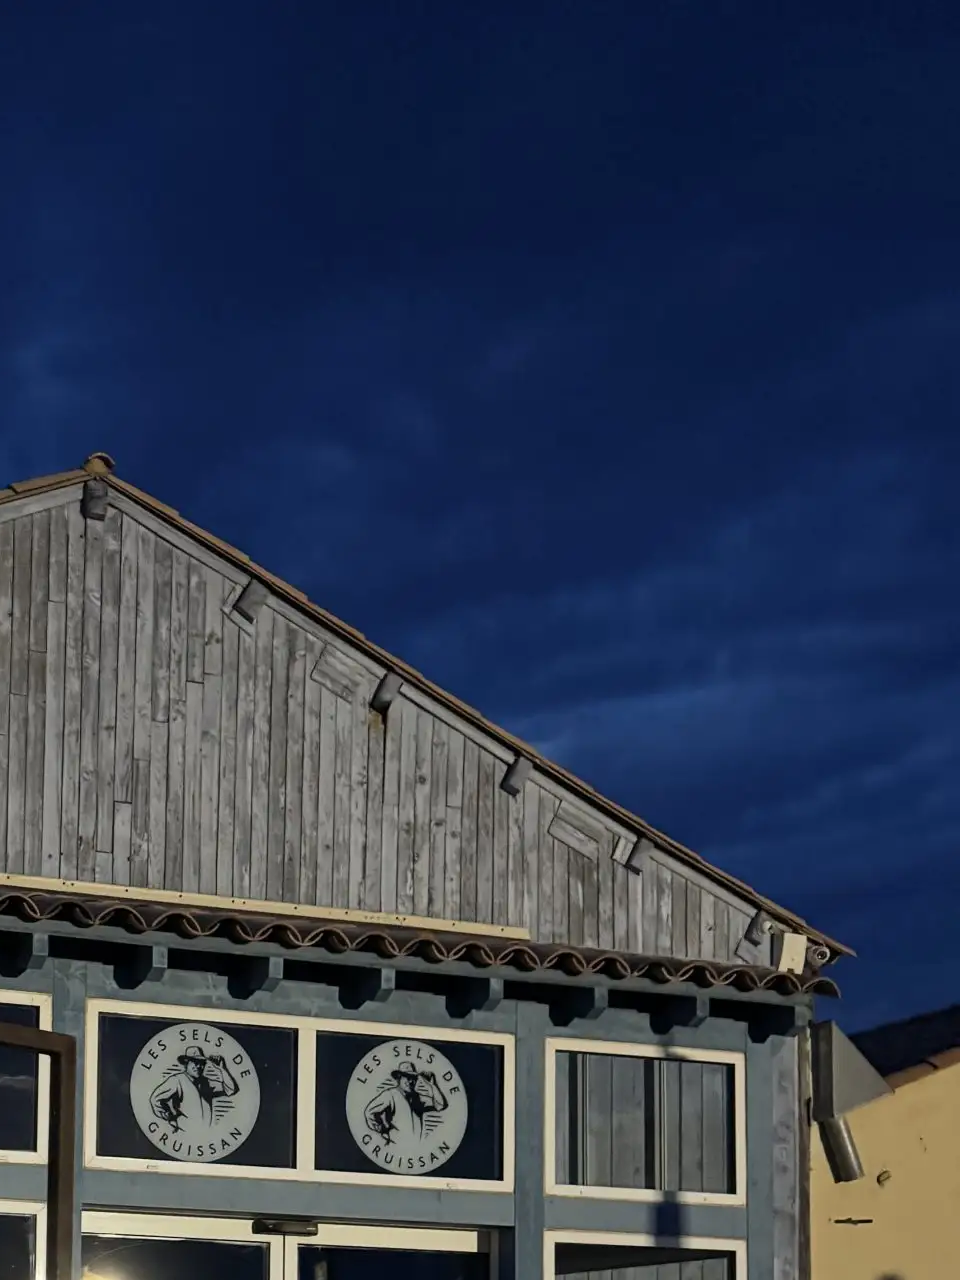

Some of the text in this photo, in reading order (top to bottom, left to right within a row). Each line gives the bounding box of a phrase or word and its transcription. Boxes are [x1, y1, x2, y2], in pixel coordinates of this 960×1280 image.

[141, 1029, 251, 1078] LES SELS DE
[357, 1045, 460, 1095] LES SELS DE
[148, 1121, 242, 1156] GRUISSAN
[361, 1133, 450, 1169] GRUISSAN
